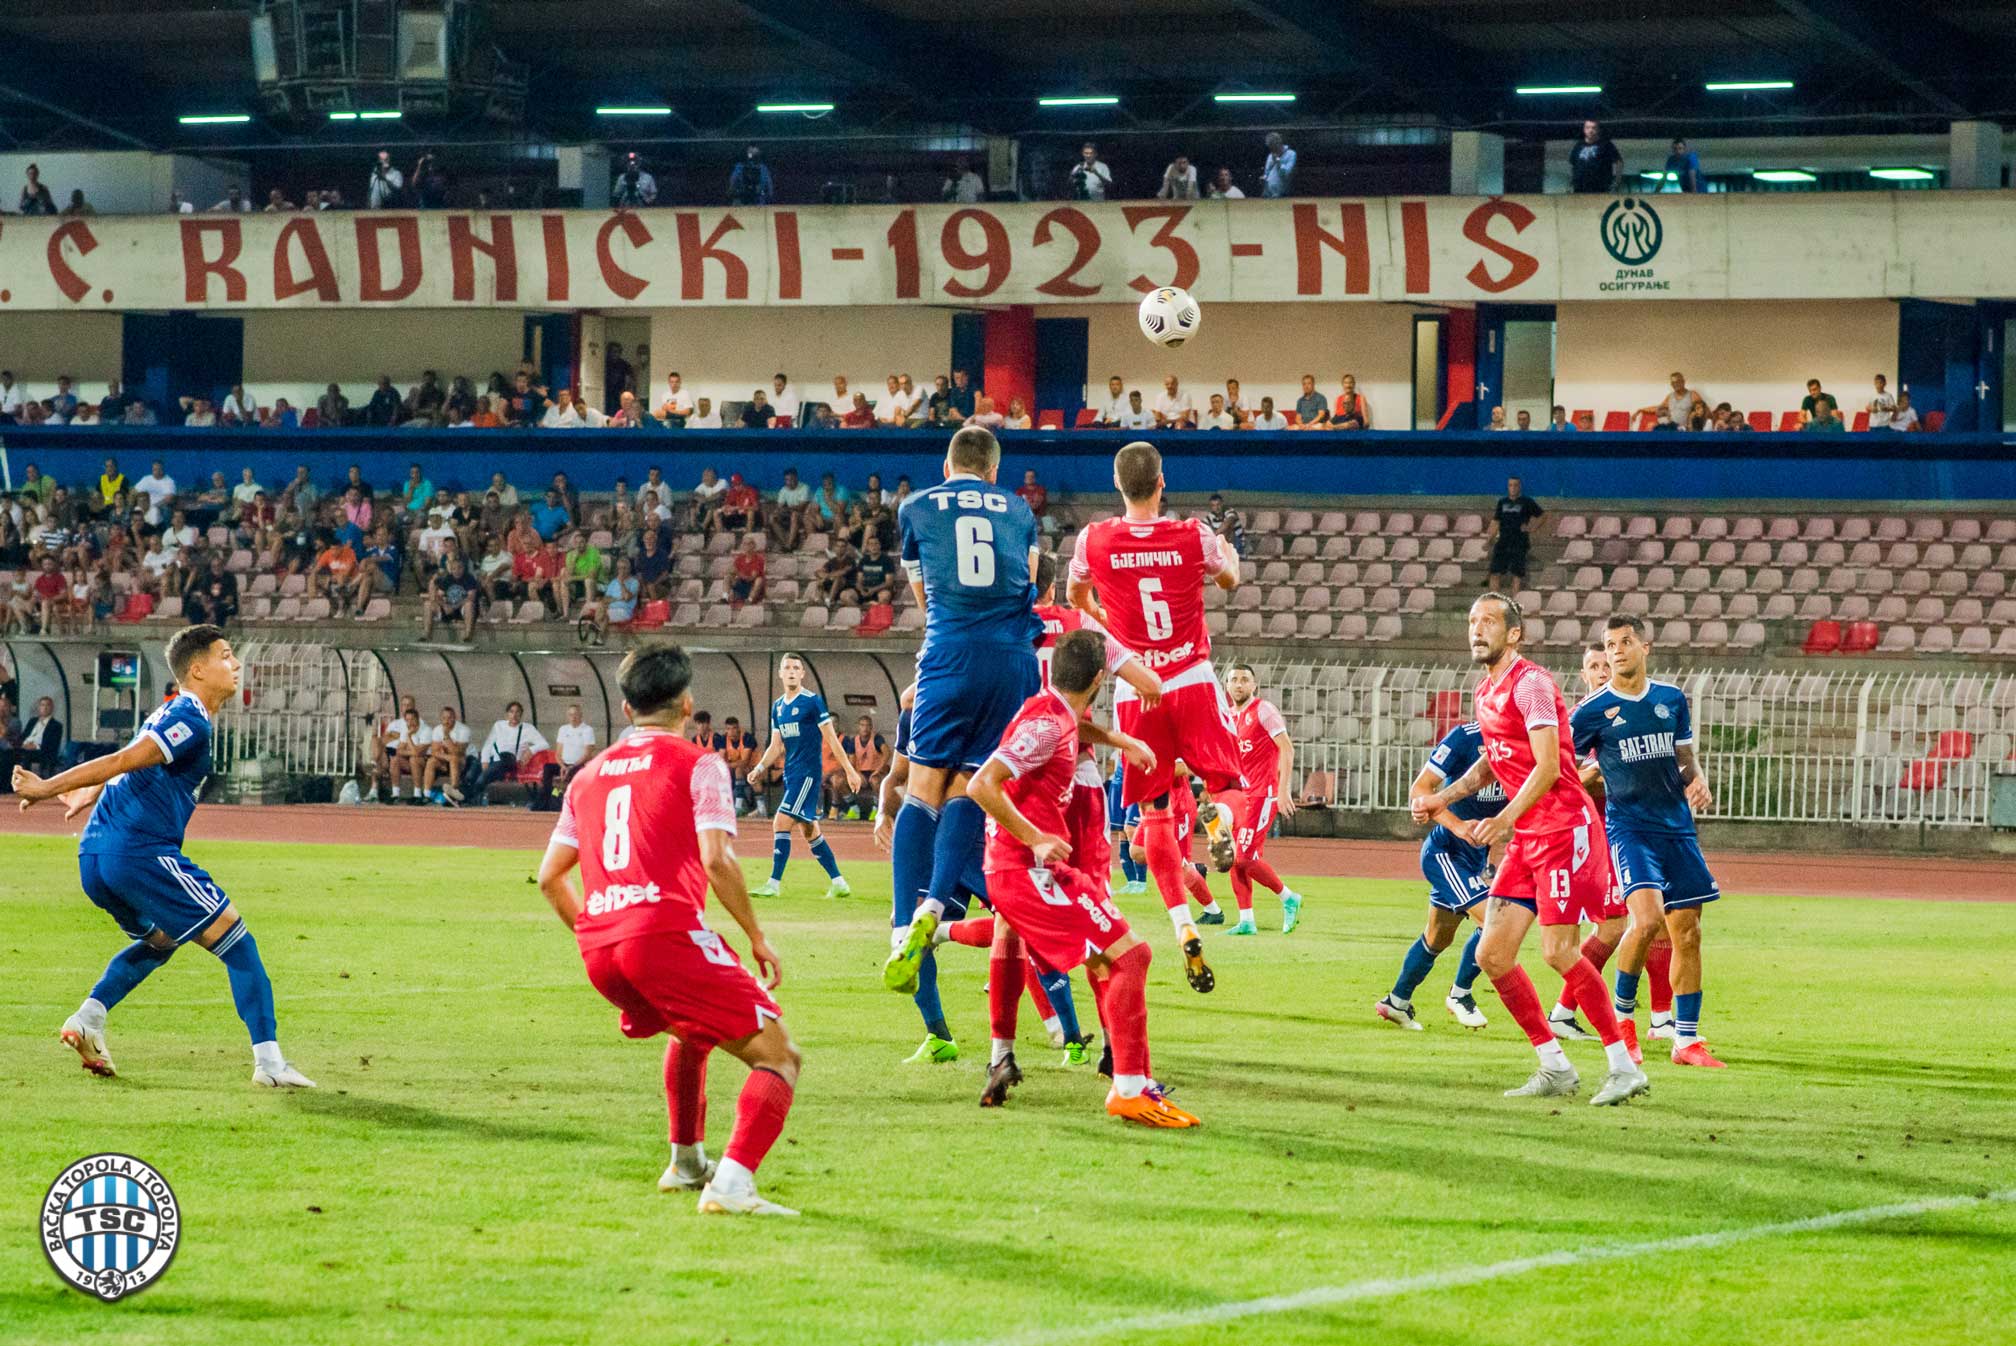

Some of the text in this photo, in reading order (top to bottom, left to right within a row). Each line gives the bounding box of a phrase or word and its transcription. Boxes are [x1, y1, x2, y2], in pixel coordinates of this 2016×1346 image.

[1599, 281, 1671, 291] ОСИГУРАЊЕ
[1615, 269, 1654, 280] ДУНАВ
[929, 490, 1008, 513] TSC
[954, 515, 996, 588] 6
[1109, 550, 1183, 569] БЈЕЛИЧИЋ
[1138, 577, 1174, 641] 6
[602, 784, 632, 872] 8
[1549, 868, 1570, 898] 13
[586, 881, 661, 916] efbet
